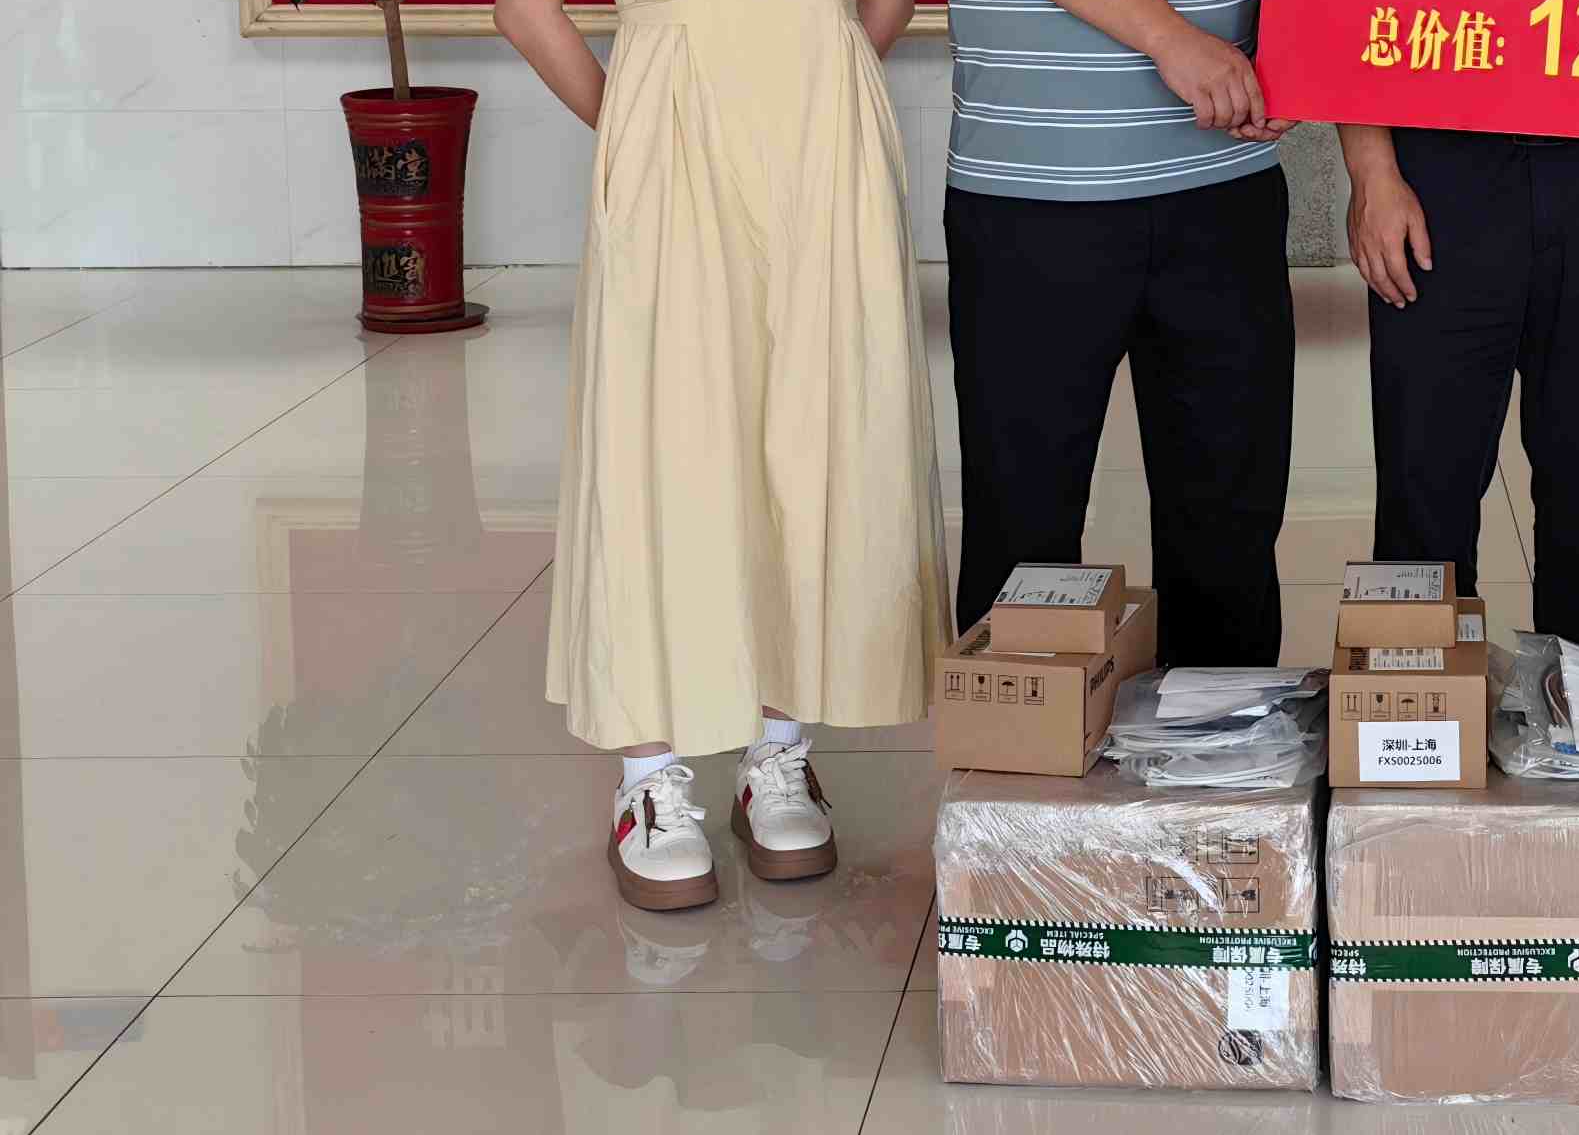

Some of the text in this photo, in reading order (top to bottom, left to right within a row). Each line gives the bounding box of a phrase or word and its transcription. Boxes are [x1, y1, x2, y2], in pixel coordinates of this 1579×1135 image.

[1382, 738, 1437, 751] 深圳-上海
[952, 925, 994, 935] EXCLUSIVE
[1046, 929, 1104, 940] SPECIAL ITEM
[1199, 936, 1297, 946] EXCLUSIVE PROTECTION
[1040, 938, 1110, 959] 特殊物品
[1457, 947, 1556, 956] EXCLUSIVE PROTECTION
[1212, 946, 1284, 964] 专属保障
[1471, 957, 1543, 975] 专属保障
